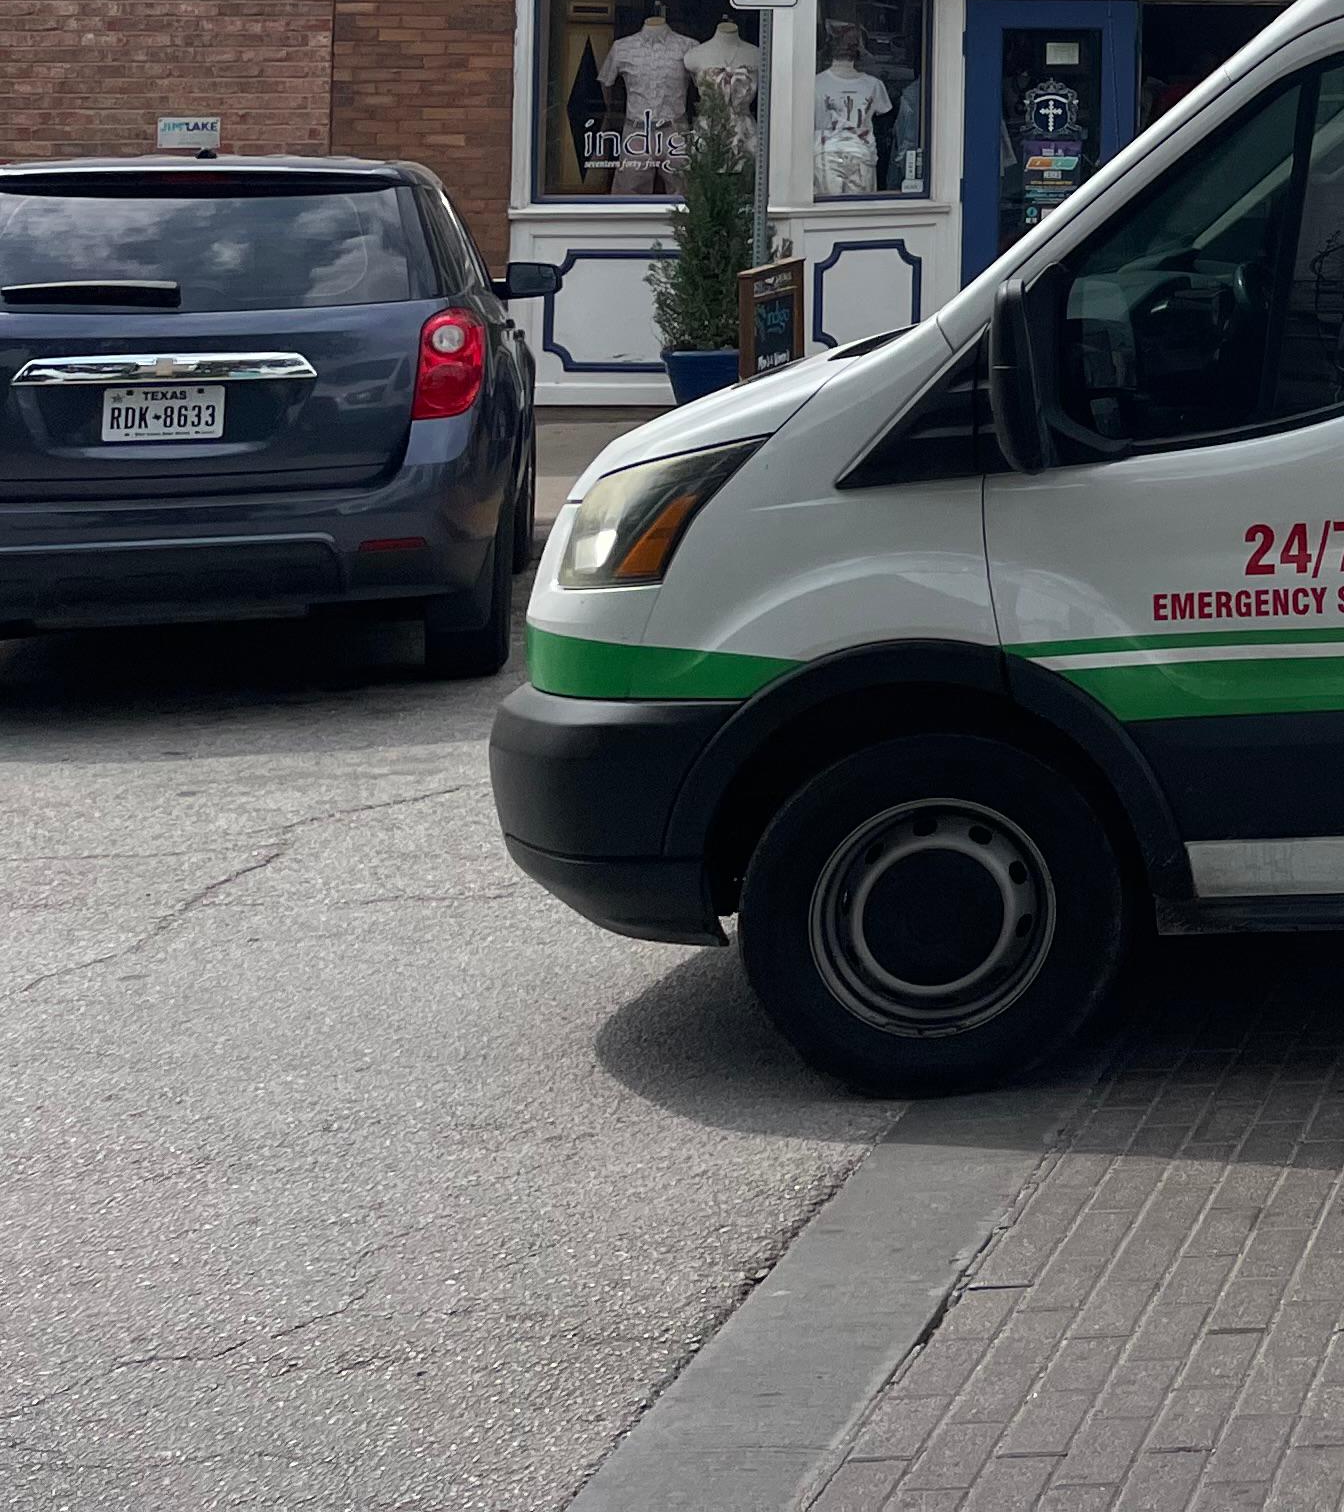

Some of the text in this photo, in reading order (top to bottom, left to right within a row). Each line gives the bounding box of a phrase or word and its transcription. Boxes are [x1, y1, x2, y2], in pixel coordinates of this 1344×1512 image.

[142, 390, 187, 401] TEXAS
[109, 404, 217, 429] RDK 8633
[1152, 587, 1328, 621] EMERGENCY
